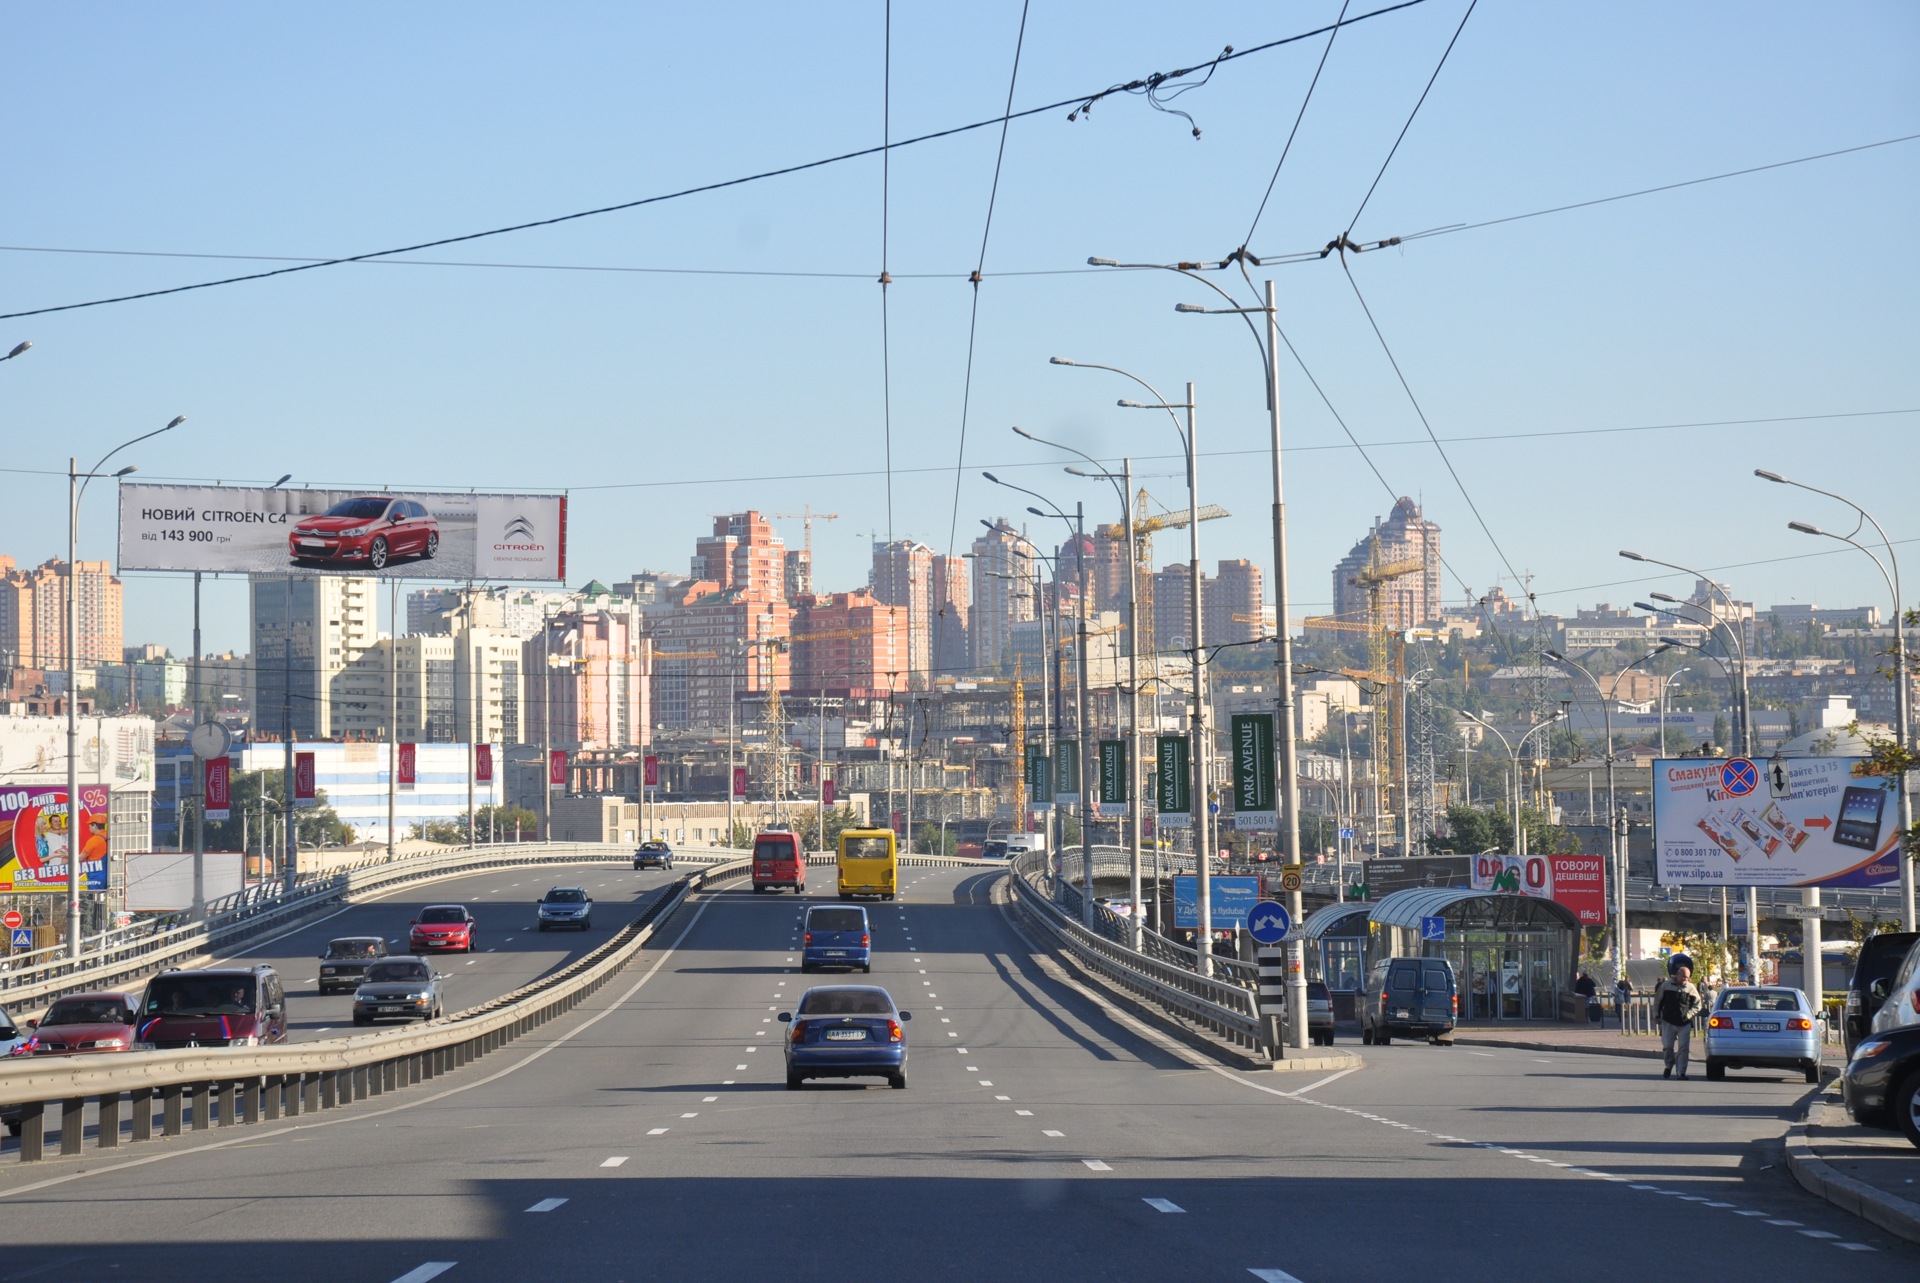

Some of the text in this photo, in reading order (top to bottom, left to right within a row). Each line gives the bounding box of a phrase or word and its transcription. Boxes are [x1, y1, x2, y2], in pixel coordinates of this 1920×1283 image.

[141, 507, 287, 524] НОВИЙ CITROËN C4
[141, 532, 157, 541] від
[160, 530, 185, 542] 143
[188, 530, 213, 542] 900
[1105, 745, 1113, 778] AVENUE
[1241, 721, 1255, 807] PARK AVENUE
[1668, 763, 1723, 782] Смакуйт
[1814, 765, 1818, 774] 1
[1828, 762, 1838, 772] 15
[1164, 742, 1174, 810] PARK AVENUE
[1790, 777, 1829, 789] ланшетних
[0, 790, 30, 812] 100
[31, 794, 56, 808] ДНІВ
[43, 800, 85, 816] КРЕДУ
[1172, 816, 1183, 824] 501
[1183, 816, 1188, 824] 4
[1238, 815, 1274, 825] 501 501 4
[1674, 848, 1721, 857] 0 800 301 707
[14, 859, 103, 882] БЕЗ ПЕРЕАТИ
[1555, 860, 1599, 871] ГОВОРИ
[1526, 858, 1546, 888] 0
[1555, 872, 1599, 881] ДЕШЕВШЕ!
[1666, 869, 1724, 880] www.silpo.ua
[1286, 877, 1297, 887] 20
[1177, 906, 1183, 914] У
[1183, 906, 1198, 916] Дуб
[1580, 909, 1601, 921] life:)
